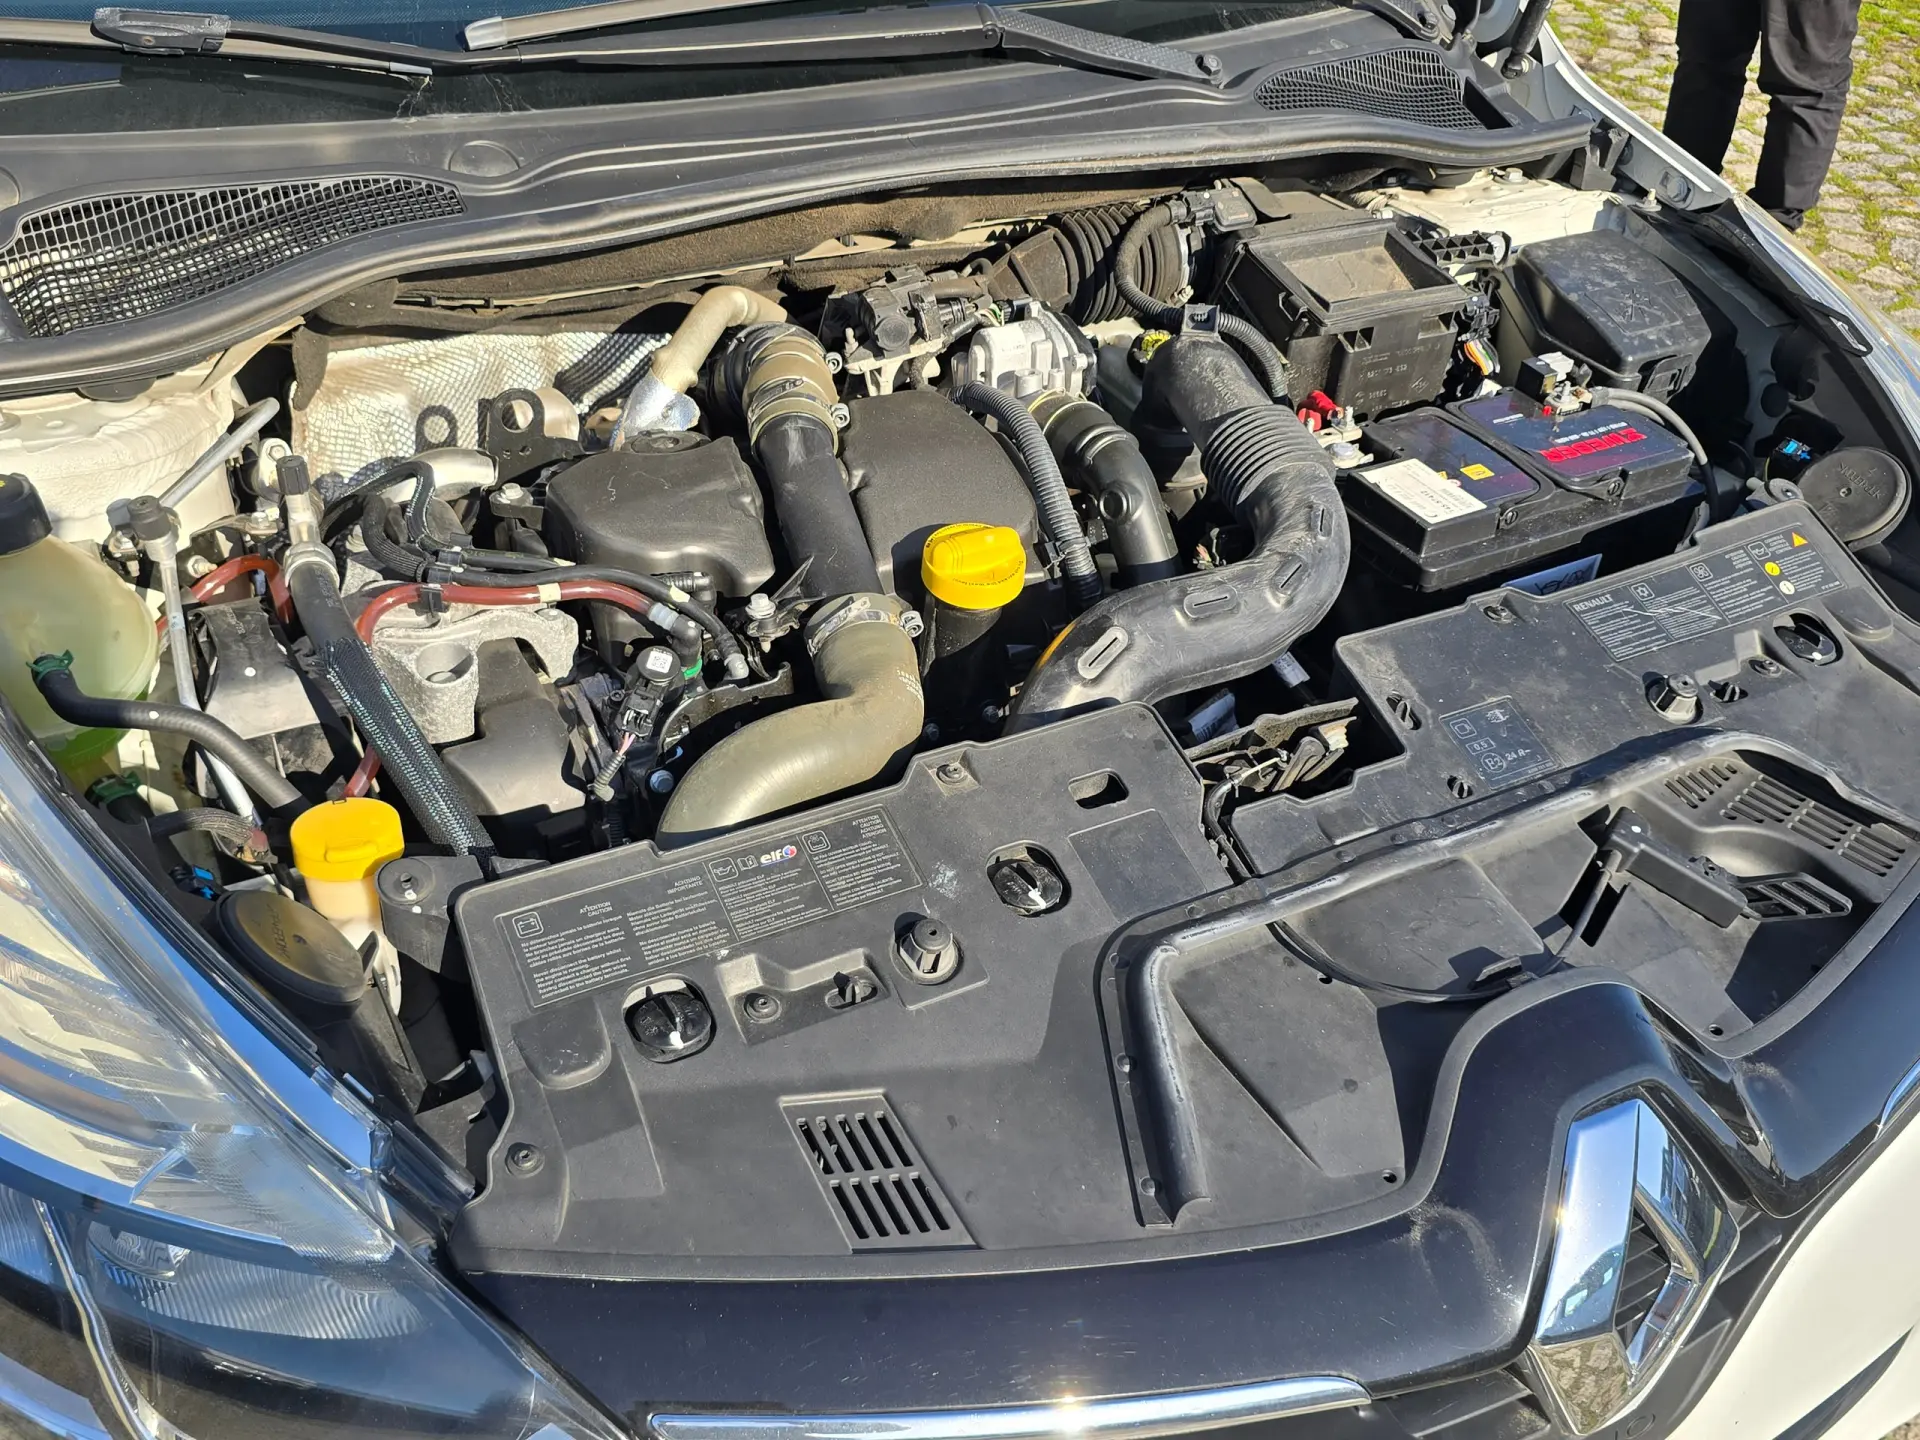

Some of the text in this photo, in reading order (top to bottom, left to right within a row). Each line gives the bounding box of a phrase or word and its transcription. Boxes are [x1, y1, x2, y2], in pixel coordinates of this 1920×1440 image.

[1573, 594, 1613, 611] RENAULT
[1505, 752, 1517, 761] 24
[853, 815, 879, 825] ATTENTION
[860, 819, 881, 828] CAUTION
[861, 824, 883, 833] ACHTUNG
[760, 850, 784, 863] elf
[675, 876, 700, 886] ACHTUNG
[667, 881, 702, 894] IMPORTANTE
[580, 902, 610, 913] ATTENTION
[588, 907, 612, 916] CAUTION
